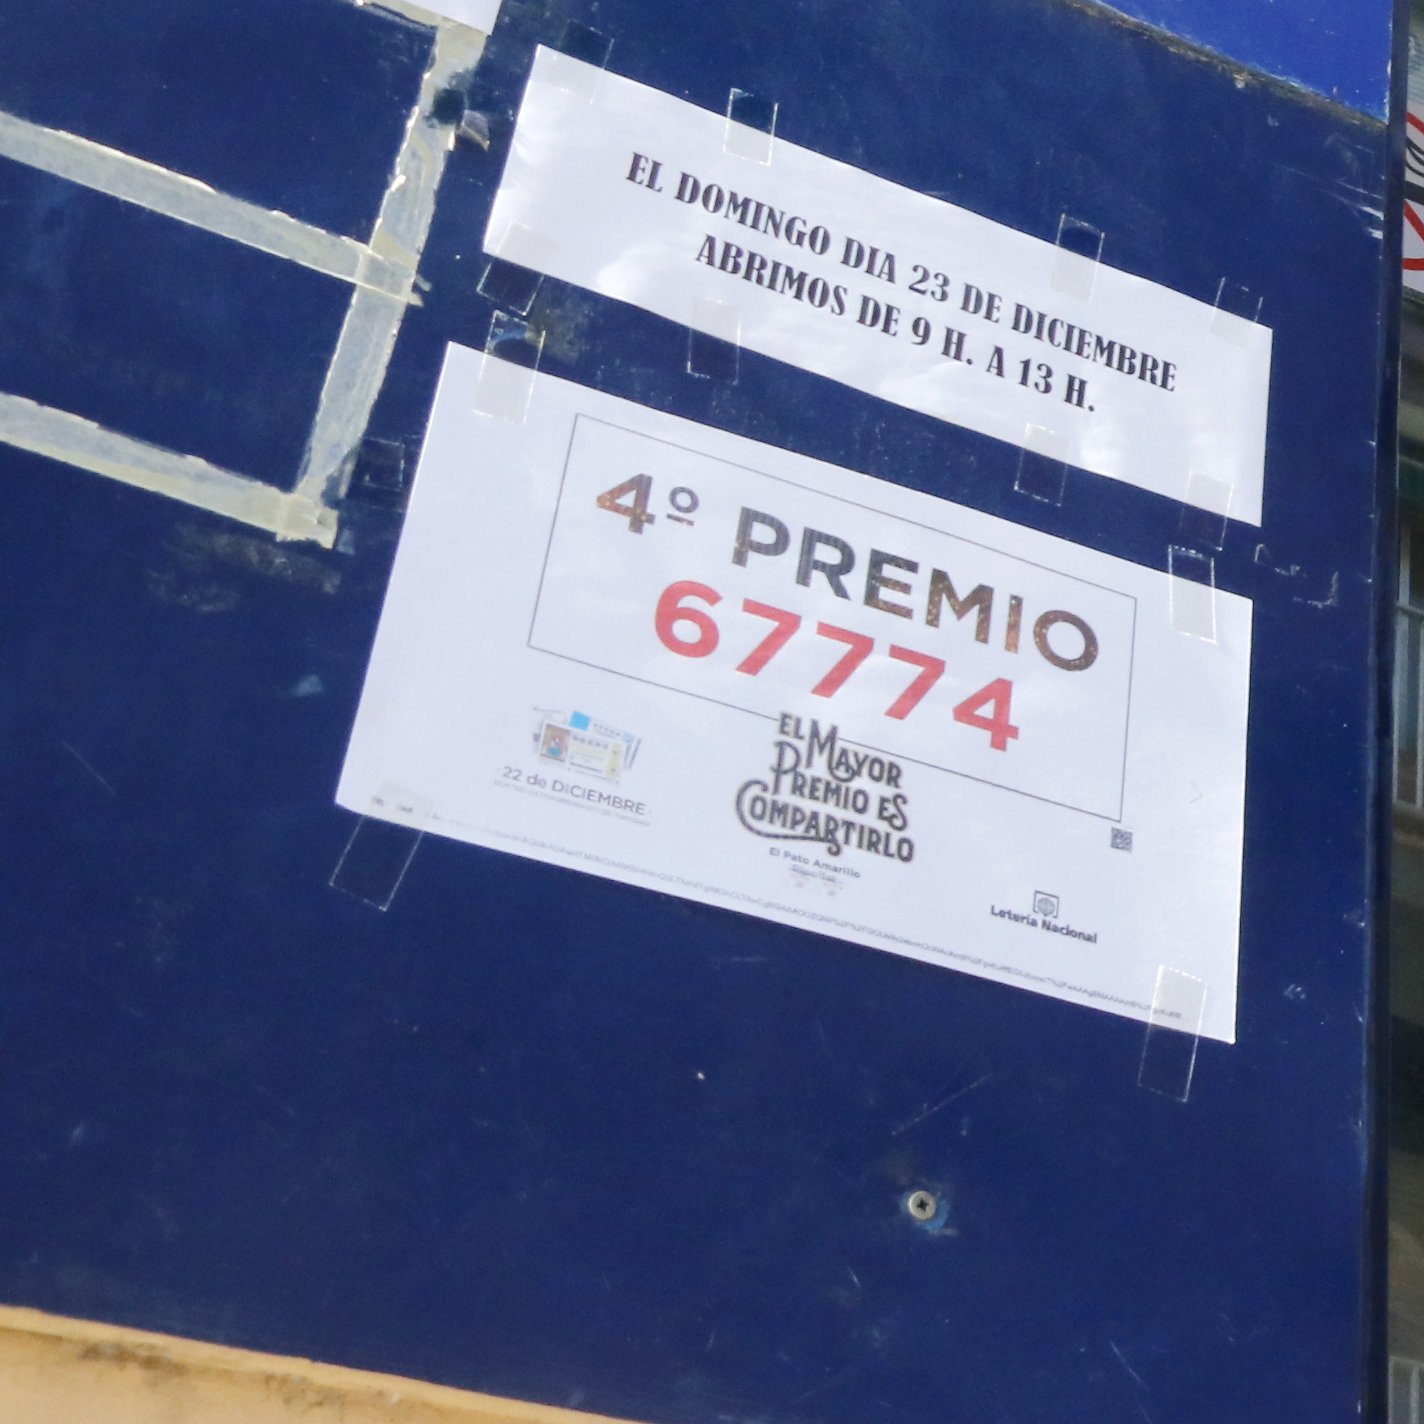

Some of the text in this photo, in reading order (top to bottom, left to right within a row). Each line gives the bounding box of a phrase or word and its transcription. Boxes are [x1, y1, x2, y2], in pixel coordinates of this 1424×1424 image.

[625, 152, 1178, 393] EL DOMINGO DIA 23 DE DICIEMBRE
[694, 233, 1097, 413] ABRIMOS DE 9 H. A 13 H.
[595, 471, 1101, 673] 4º PREMIO
[651, 578, 1022, 753] 67774
[501, 766, 646, 815] 22 de DICIEMBRE
[770, 741, 908, 831] PREMIO ES
[779, 711, 903, 788] EL MAYOR
[736, 780, 915, 863] COMPARTIRLO
[1042, 918, 1098, 944] Nacional
